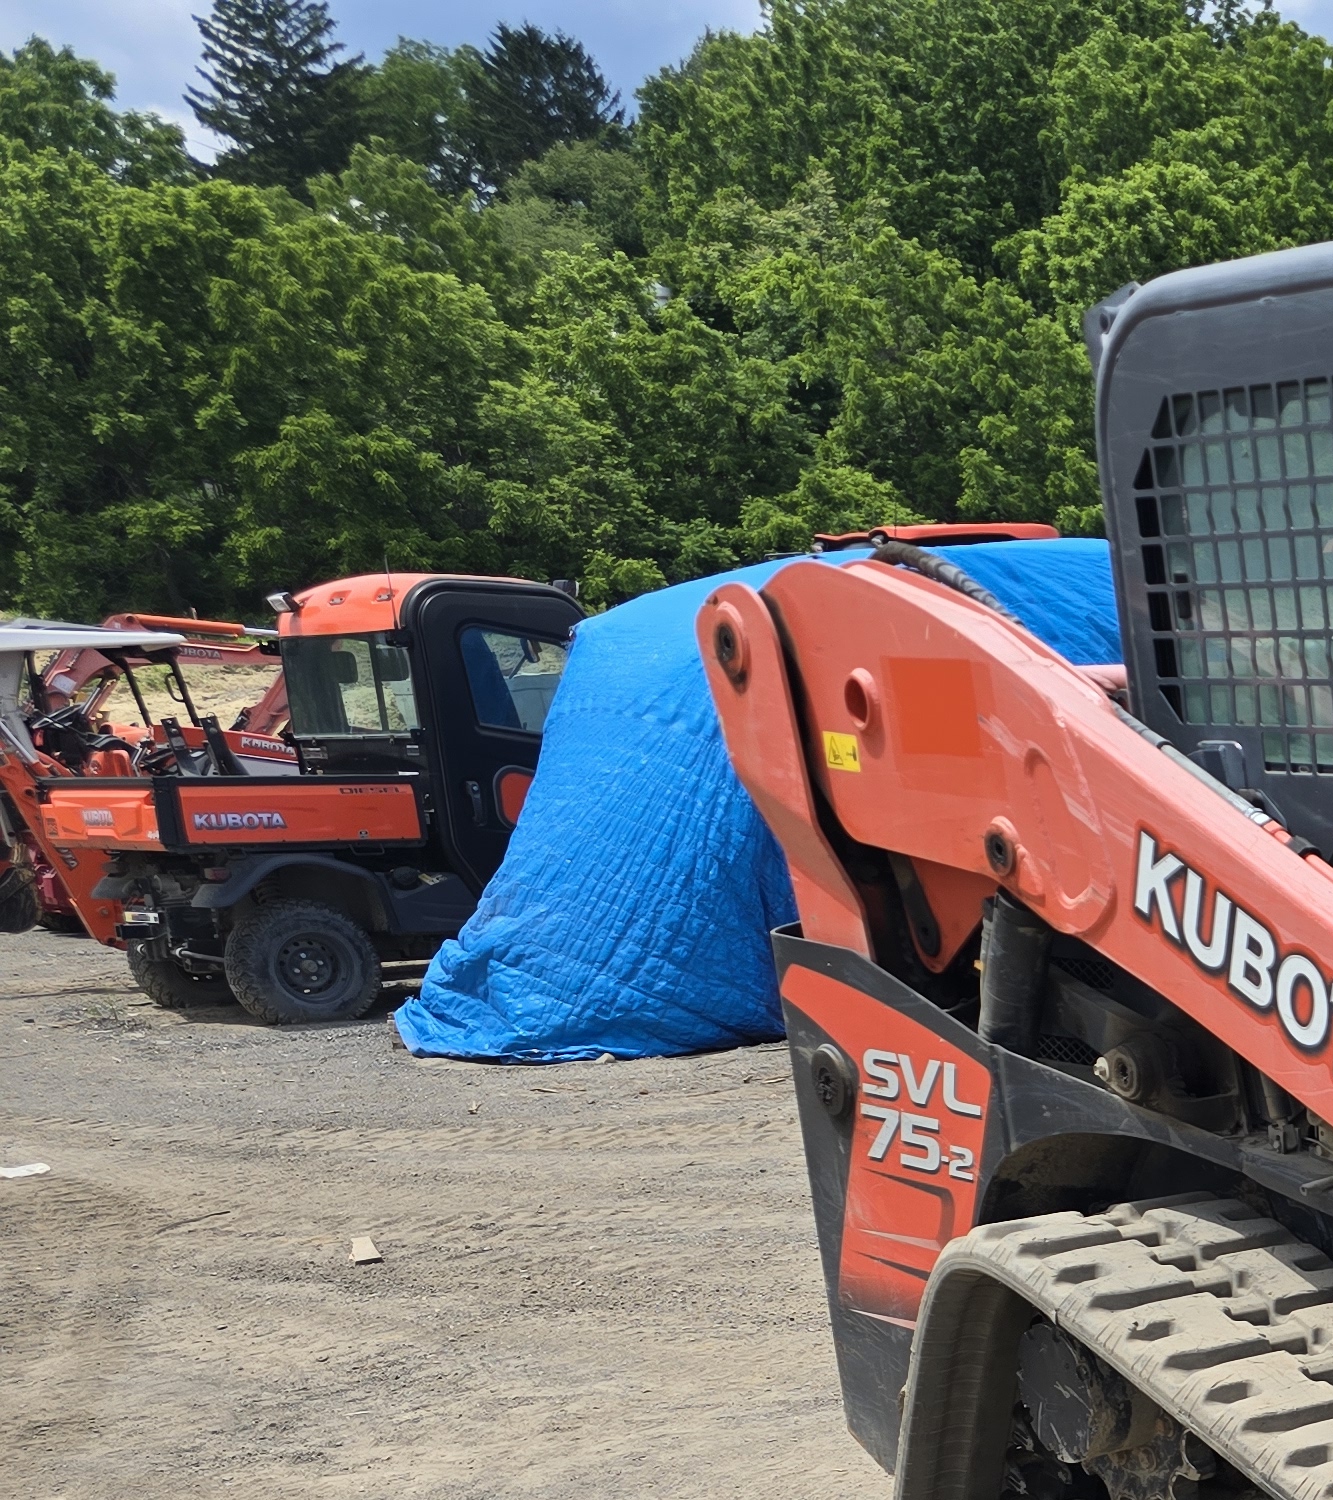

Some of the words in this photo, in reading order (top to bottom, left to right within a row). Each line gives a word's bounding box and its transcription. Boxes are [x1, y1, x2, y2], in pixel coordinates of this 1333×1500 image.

[242, 736, 296, 756] KUBOTA
[82, 809, 114, 826] KUBOTA
[193, 812, 286, 829] KUBOTA
[861, 1048, 983, 1118] SVL
[859, 1102, 975, 1182] 75-2
